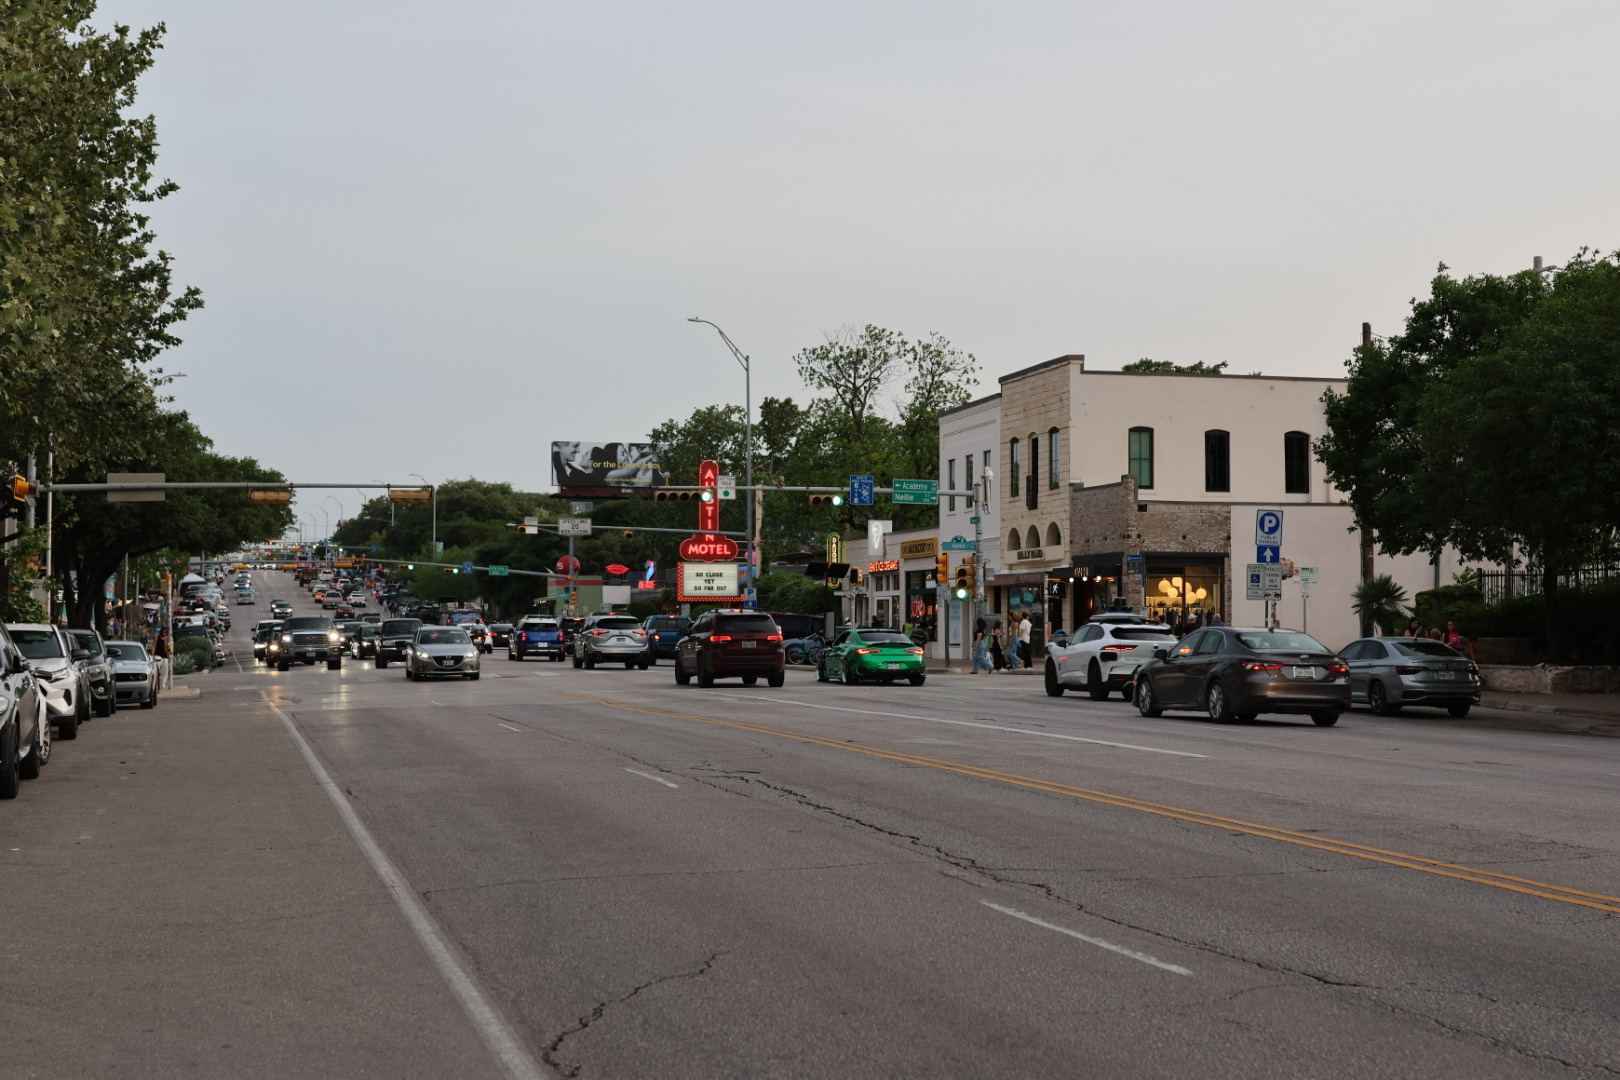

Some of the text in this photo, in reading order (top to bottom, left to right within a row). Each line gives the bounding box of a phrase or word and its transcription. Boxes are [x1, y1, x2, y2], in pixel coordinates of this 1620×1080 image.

[588, 460, 601, 468] For
[603, 460, 616, 468] the
[902, 481, 928, 491] Academy
[894, 493, 914, 501] Nellie
[688, 544, 731, 554] MOTEL
[1017, 550, 1030, 560] BILLY
